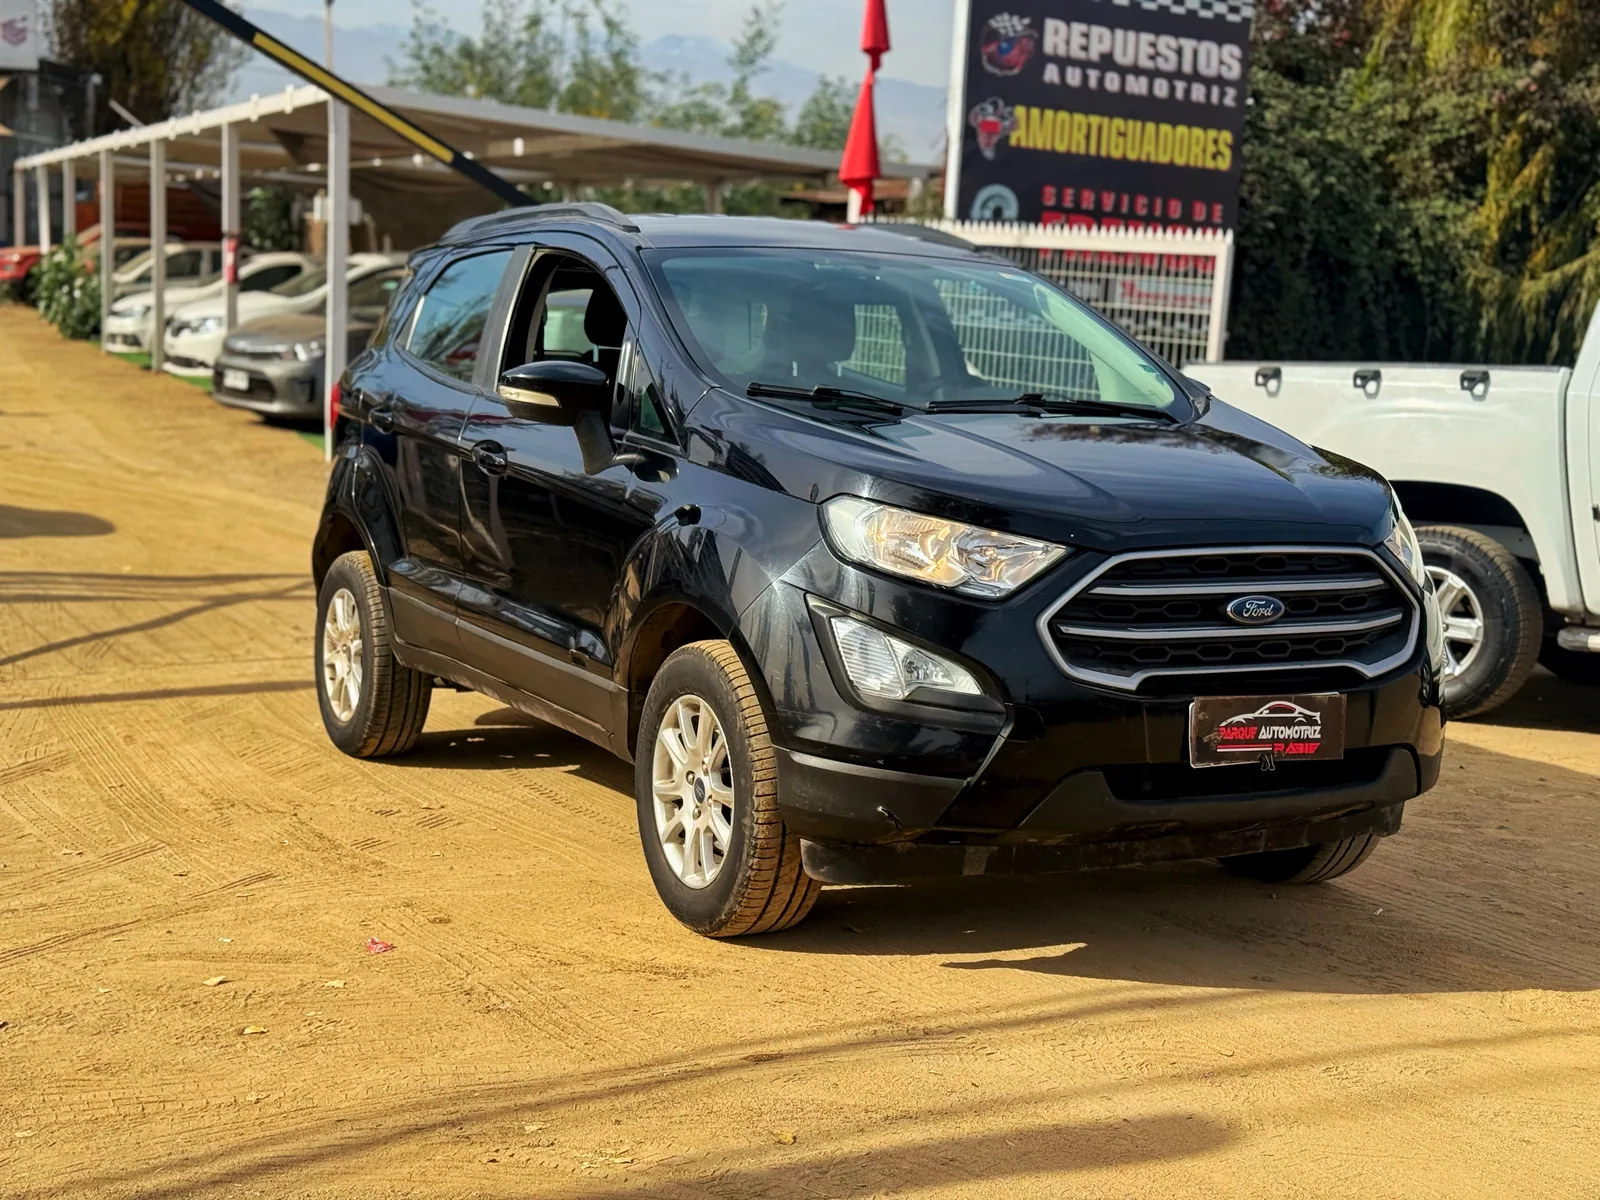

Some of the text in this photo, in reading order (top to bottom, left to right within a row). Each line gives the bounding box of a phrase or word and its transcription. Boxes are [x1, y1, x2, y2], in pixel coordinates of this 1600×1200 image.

[1043, 17, 1242, 80] REPUESTOS
[1043, 62, 1238, 108] AUTOMOTRIZ
[1009, 105, 1233, 171] AMORTIGUADORES
[1041, 184, 1224, 223] SERVICIO DE
[1242, 600, 1274, 617] Ford
[1219, 726, 1321, 740] PARQUE AUTOMOTRIZ
